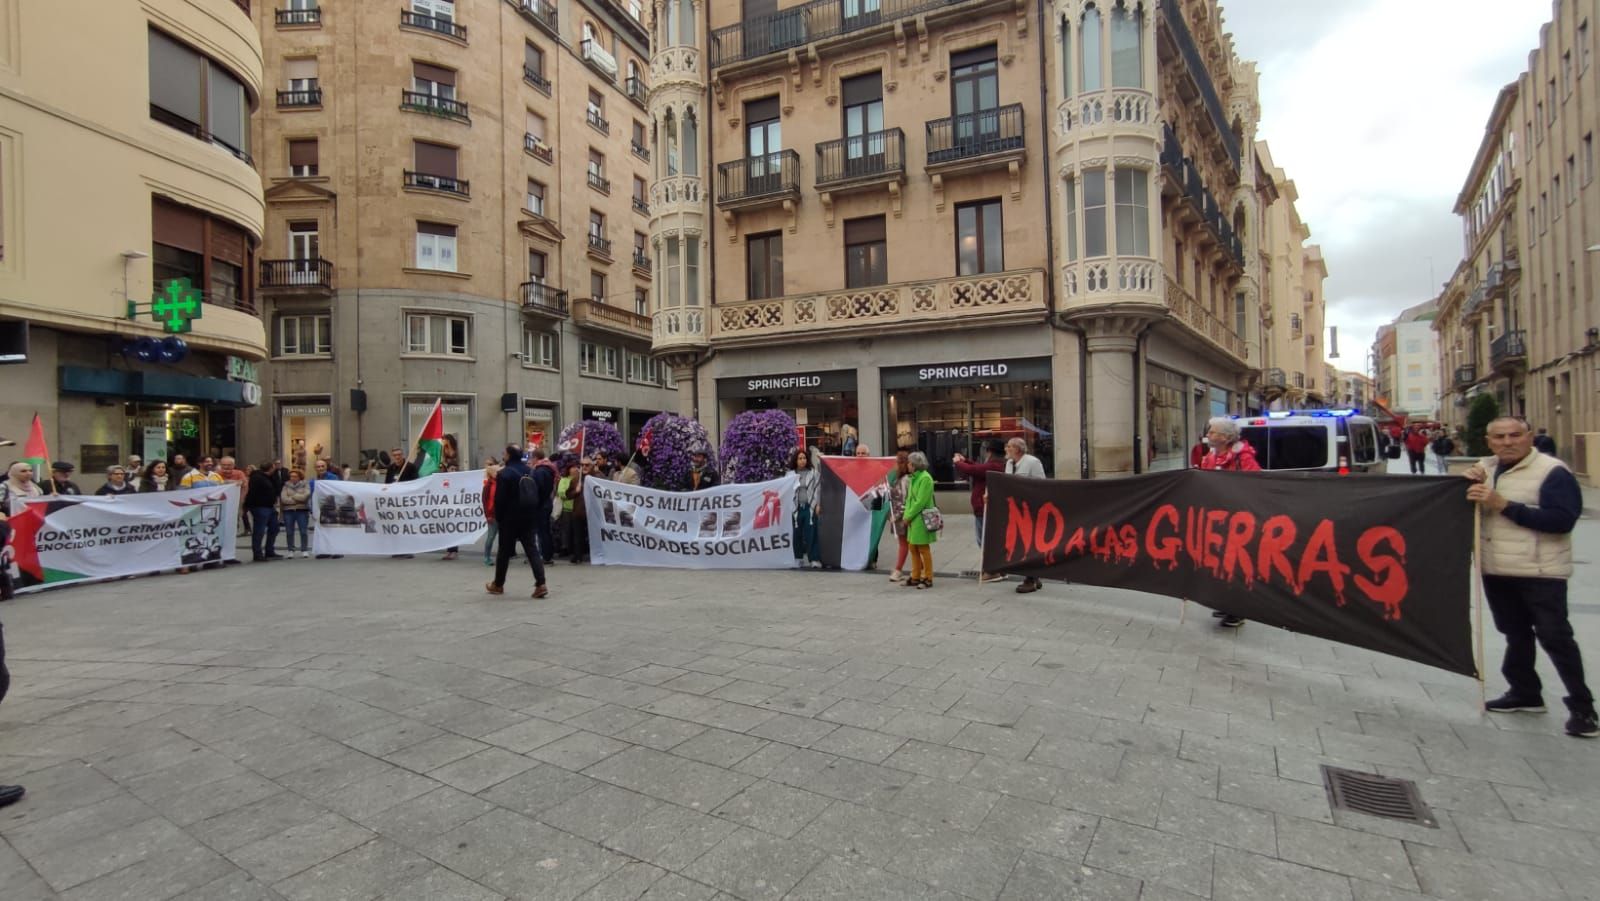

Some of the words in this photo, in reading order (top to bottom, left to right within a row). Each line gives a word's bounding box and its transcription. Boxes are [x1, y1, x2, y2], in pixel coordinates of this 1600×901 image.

[919, 364, 1008, 380] SPRINGFIELD
[748, 376, 821, 391] SPRINGFIELD
[592, 410, 612, 418] MANGO
[593, 485, 655, 509] GASTOS
[657, 494, 742, 512] MILITARES
[378, 511, 394, 521] NO
[398, 511, 405, 520] A
[407, 510, 419, 520] LA
[422, 506, 484, 519] OCUPACIÓ
[37, 526, 112, 542] IONISMO
[117, 518, 196, 535] CRIMINAL
[382, 524, 399, 534] NO
[403, 523, 417, 534] AL
[644, 516, 689, 533] PARA
[36, 540, 96, 552] ENOCIDIO
[100, 529, 196, 546] INTERNACIONAL
[601, 529, 700, 556] NECESIDADES
[705, 533, 791, 556] SOCIALES
[1005, 497, 1064, 564] NO
[1064, 527, 1086, 555] A
[1089, 524, 1138, 567] LAS
[1145, 504, 1408, 621] GUERRAS
